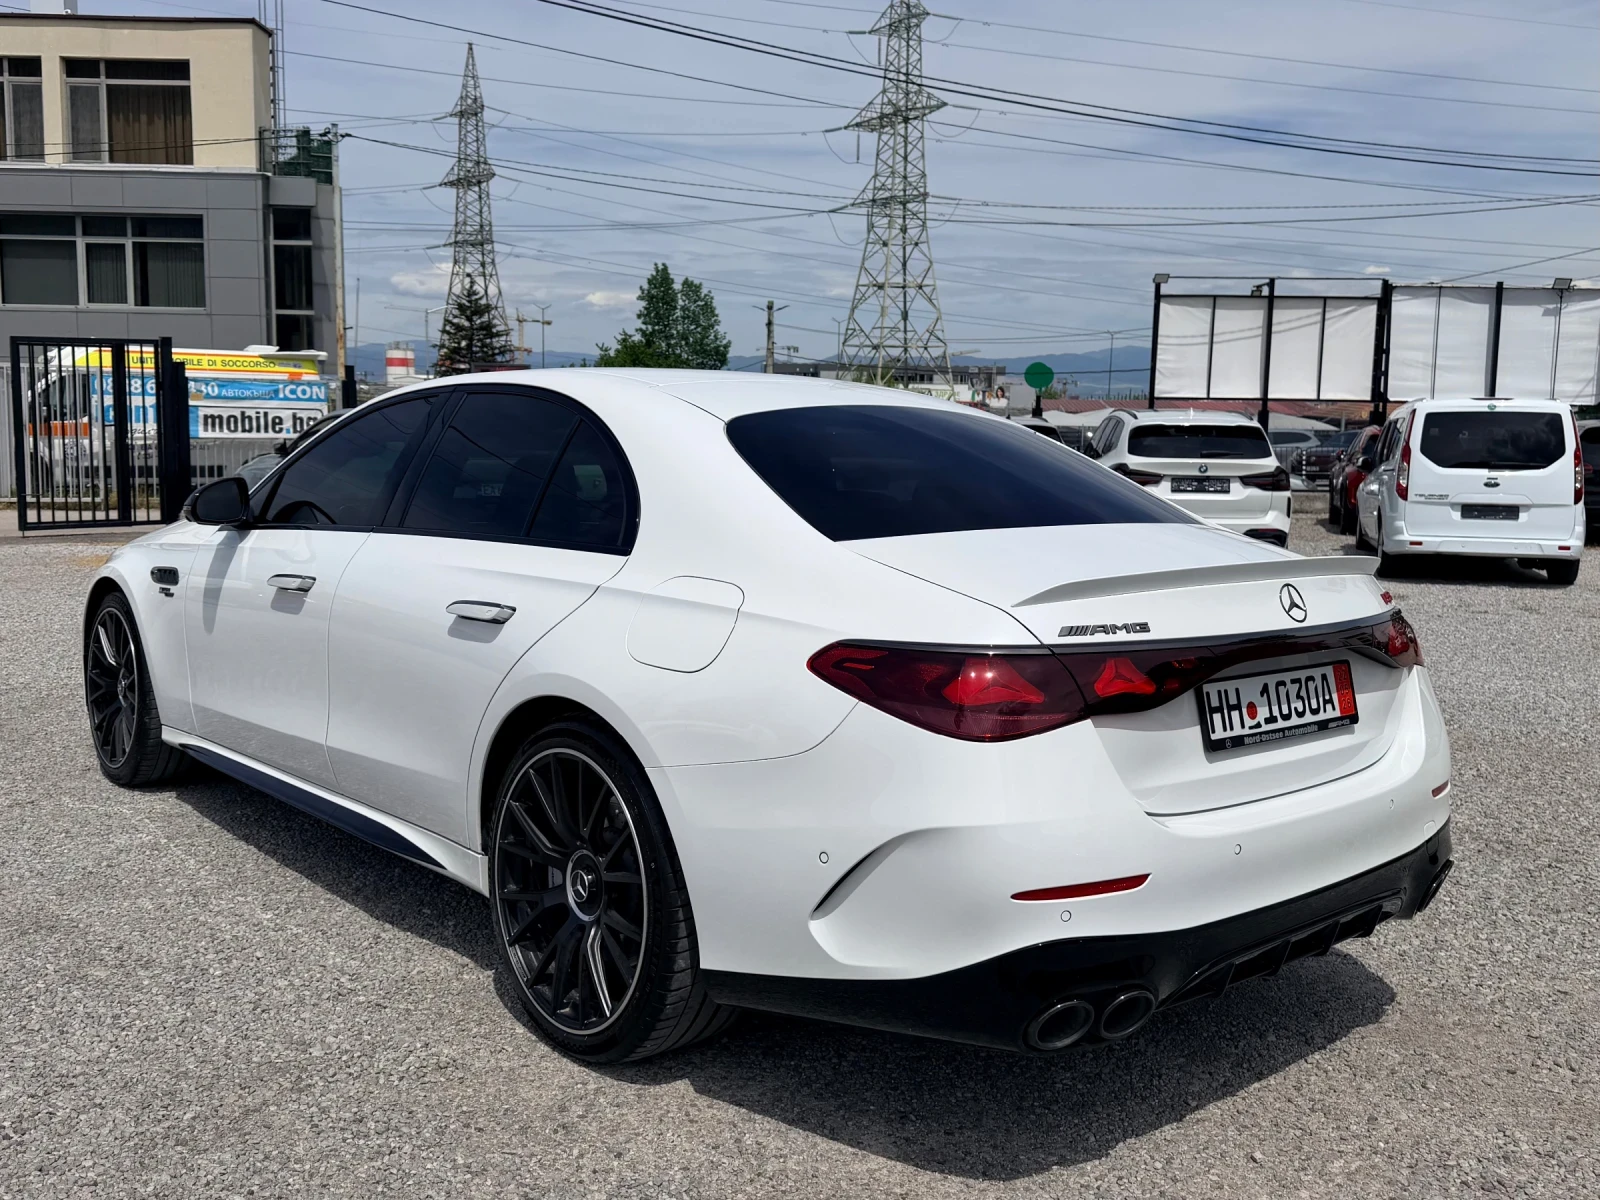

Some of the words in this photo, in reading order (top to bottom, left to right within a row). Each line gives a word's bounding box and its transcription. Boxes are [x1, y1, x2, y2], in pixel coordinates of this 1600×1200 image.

[131, 356, 155, 365] UNIT
[172, 357, 203, 366] OBILE
[207, 359, 217, 367] DI
[220, 359, 276, 368] SOCCORSO
[221, 388, 275, 399] АВТОКЪЩА
[278, 384, 325, 399] ICON
[1088, 621, 1151, 636] AMG
[1205, 687, 1246, 734] HH
[1259, 673, 1336, 725] 1030A
[1244, 729, 1284, 745] Nord-Ostsee
[1284, 723, 1319, 737] Automobile
